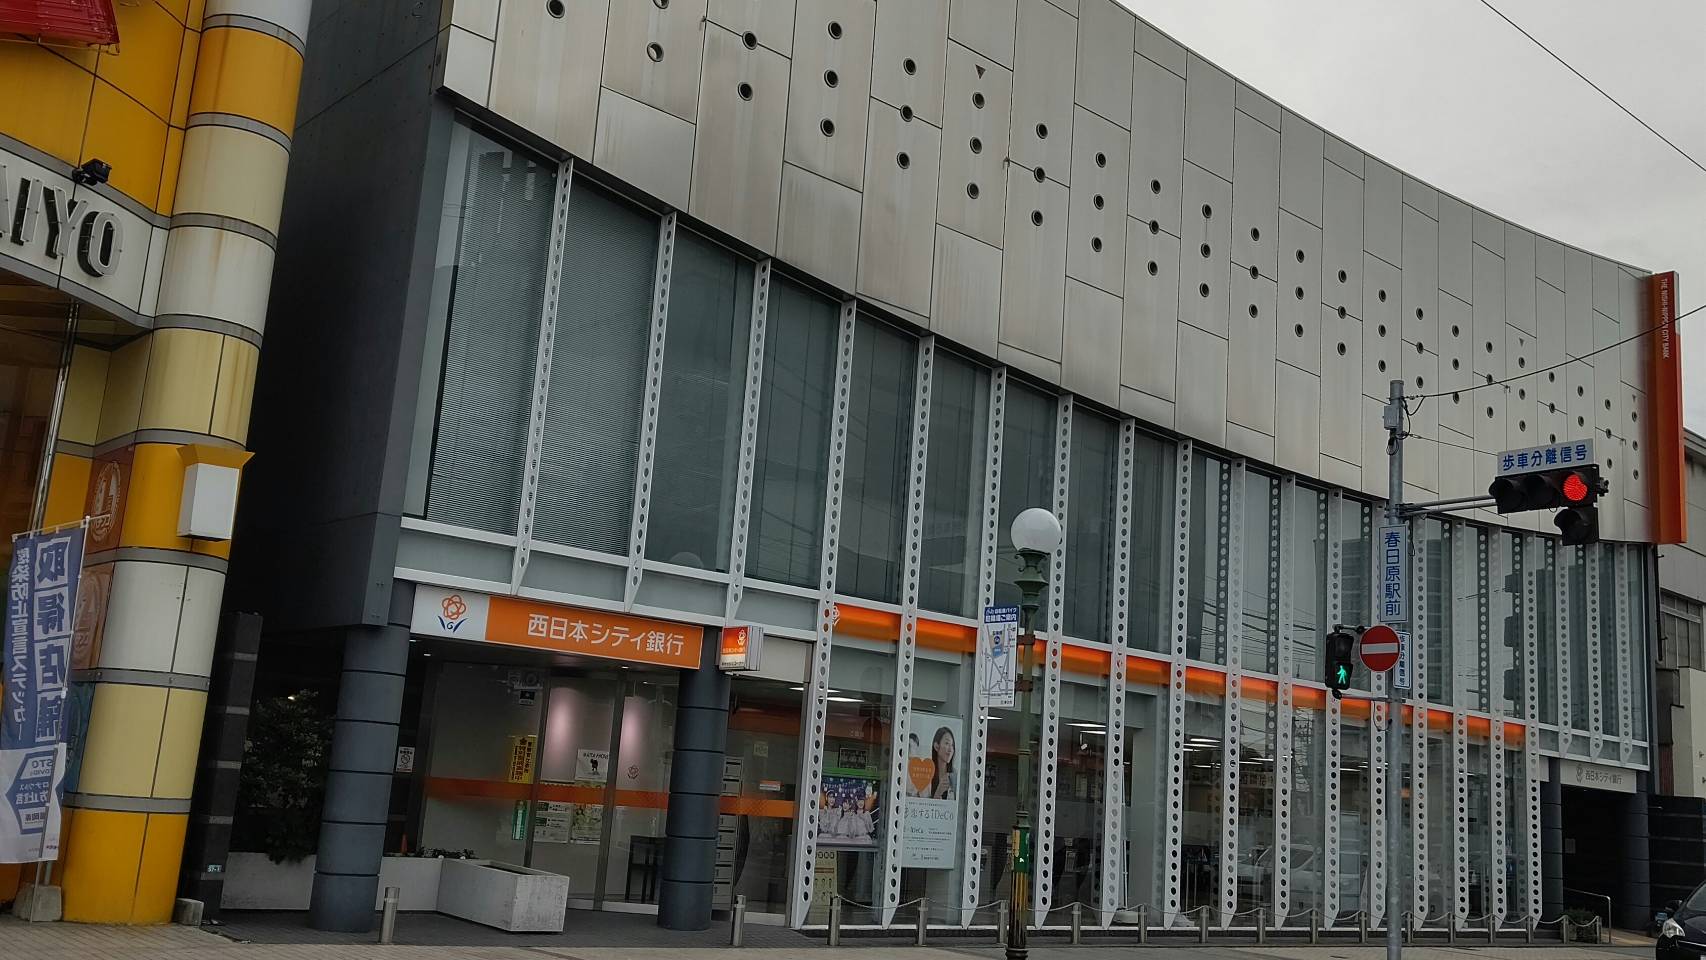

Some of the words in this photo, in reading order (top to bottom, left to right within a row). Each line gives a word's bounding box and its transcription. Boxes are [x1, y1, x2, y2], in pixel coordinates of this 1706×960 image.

[0, 165, 124, 278] IYO
[1503, 444, 1588, 471] 歩車分離信号
[1384, 531, 1401, 616] 春日原駅前
[527, 613, 684, 656] 西日本シティ銀行
